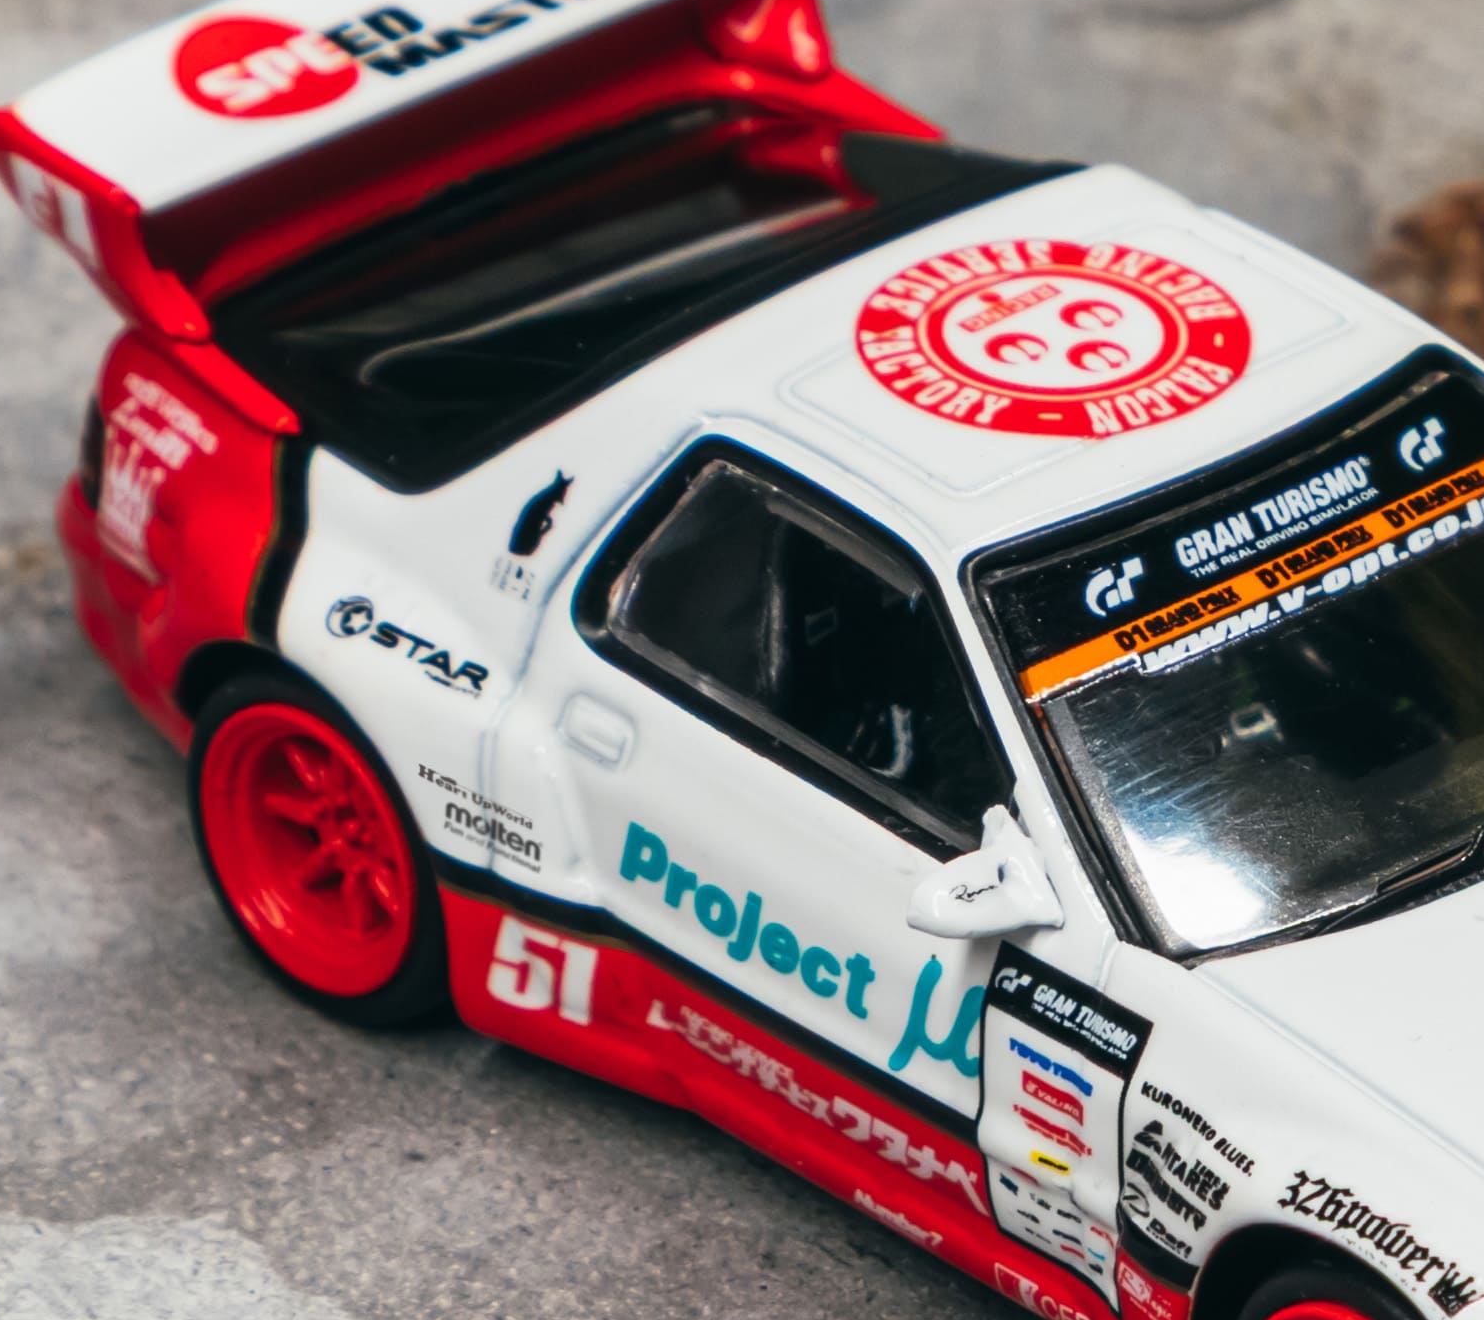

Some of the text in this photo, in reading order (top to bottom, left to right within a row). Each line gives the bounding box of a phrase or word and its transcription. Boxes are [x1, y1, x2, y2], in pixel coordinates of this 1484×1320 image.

[195, 6, 424, 115] SPEED
[873, 239, 1237, 322] RACING SERVICE
[1085, 355, 1235, 435] FALCON
[1175, 455, 1371, 568] GRAN TURISMO
[369, 621, 489, 691] STAR
[445, 801, 542, 862] molten
[486, 914, 599, 1027] 51
[1033, 984, 1077, 1019] GRAN
[1141, 1080, 1218, 1141] KURONEKO
